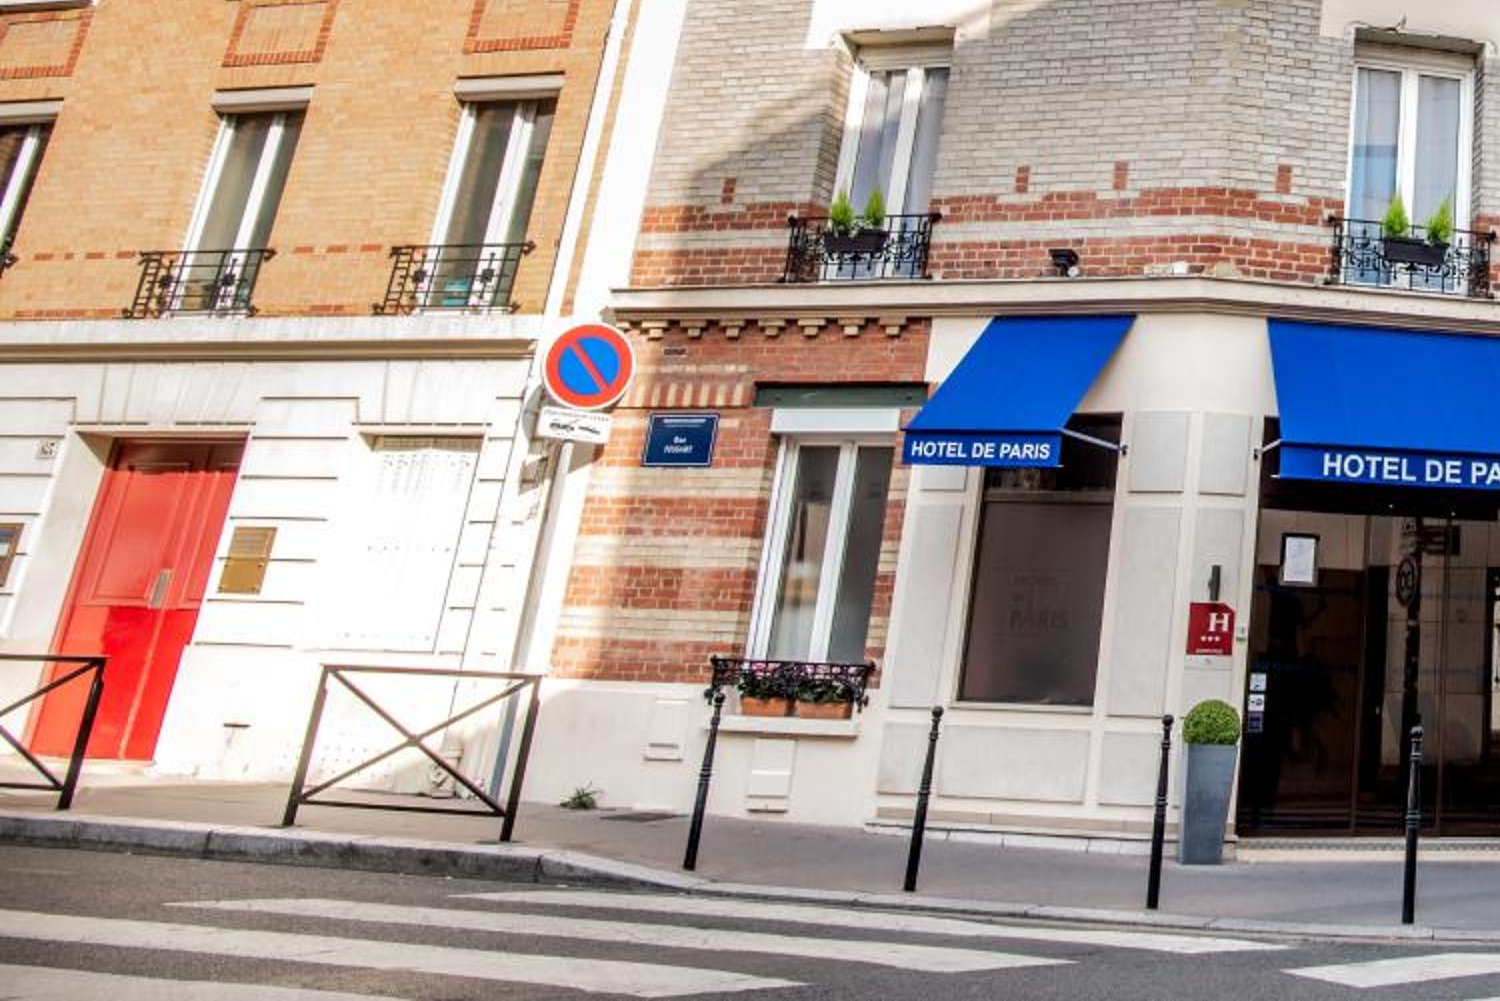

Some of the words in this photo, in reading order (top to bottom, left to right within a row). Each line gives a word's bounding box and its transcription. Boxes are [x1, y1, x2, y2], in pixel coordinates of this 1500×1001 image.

[911, 441, 967, 458] HOTEL
[972, 442, 995, 459] DE
[999, 443, 1051, 460] PARIS
[1323, 452, 1416, 482] HOTEL
[1425, 460, 1462, 484] DE
[1208, 612, 1231, 632] H
